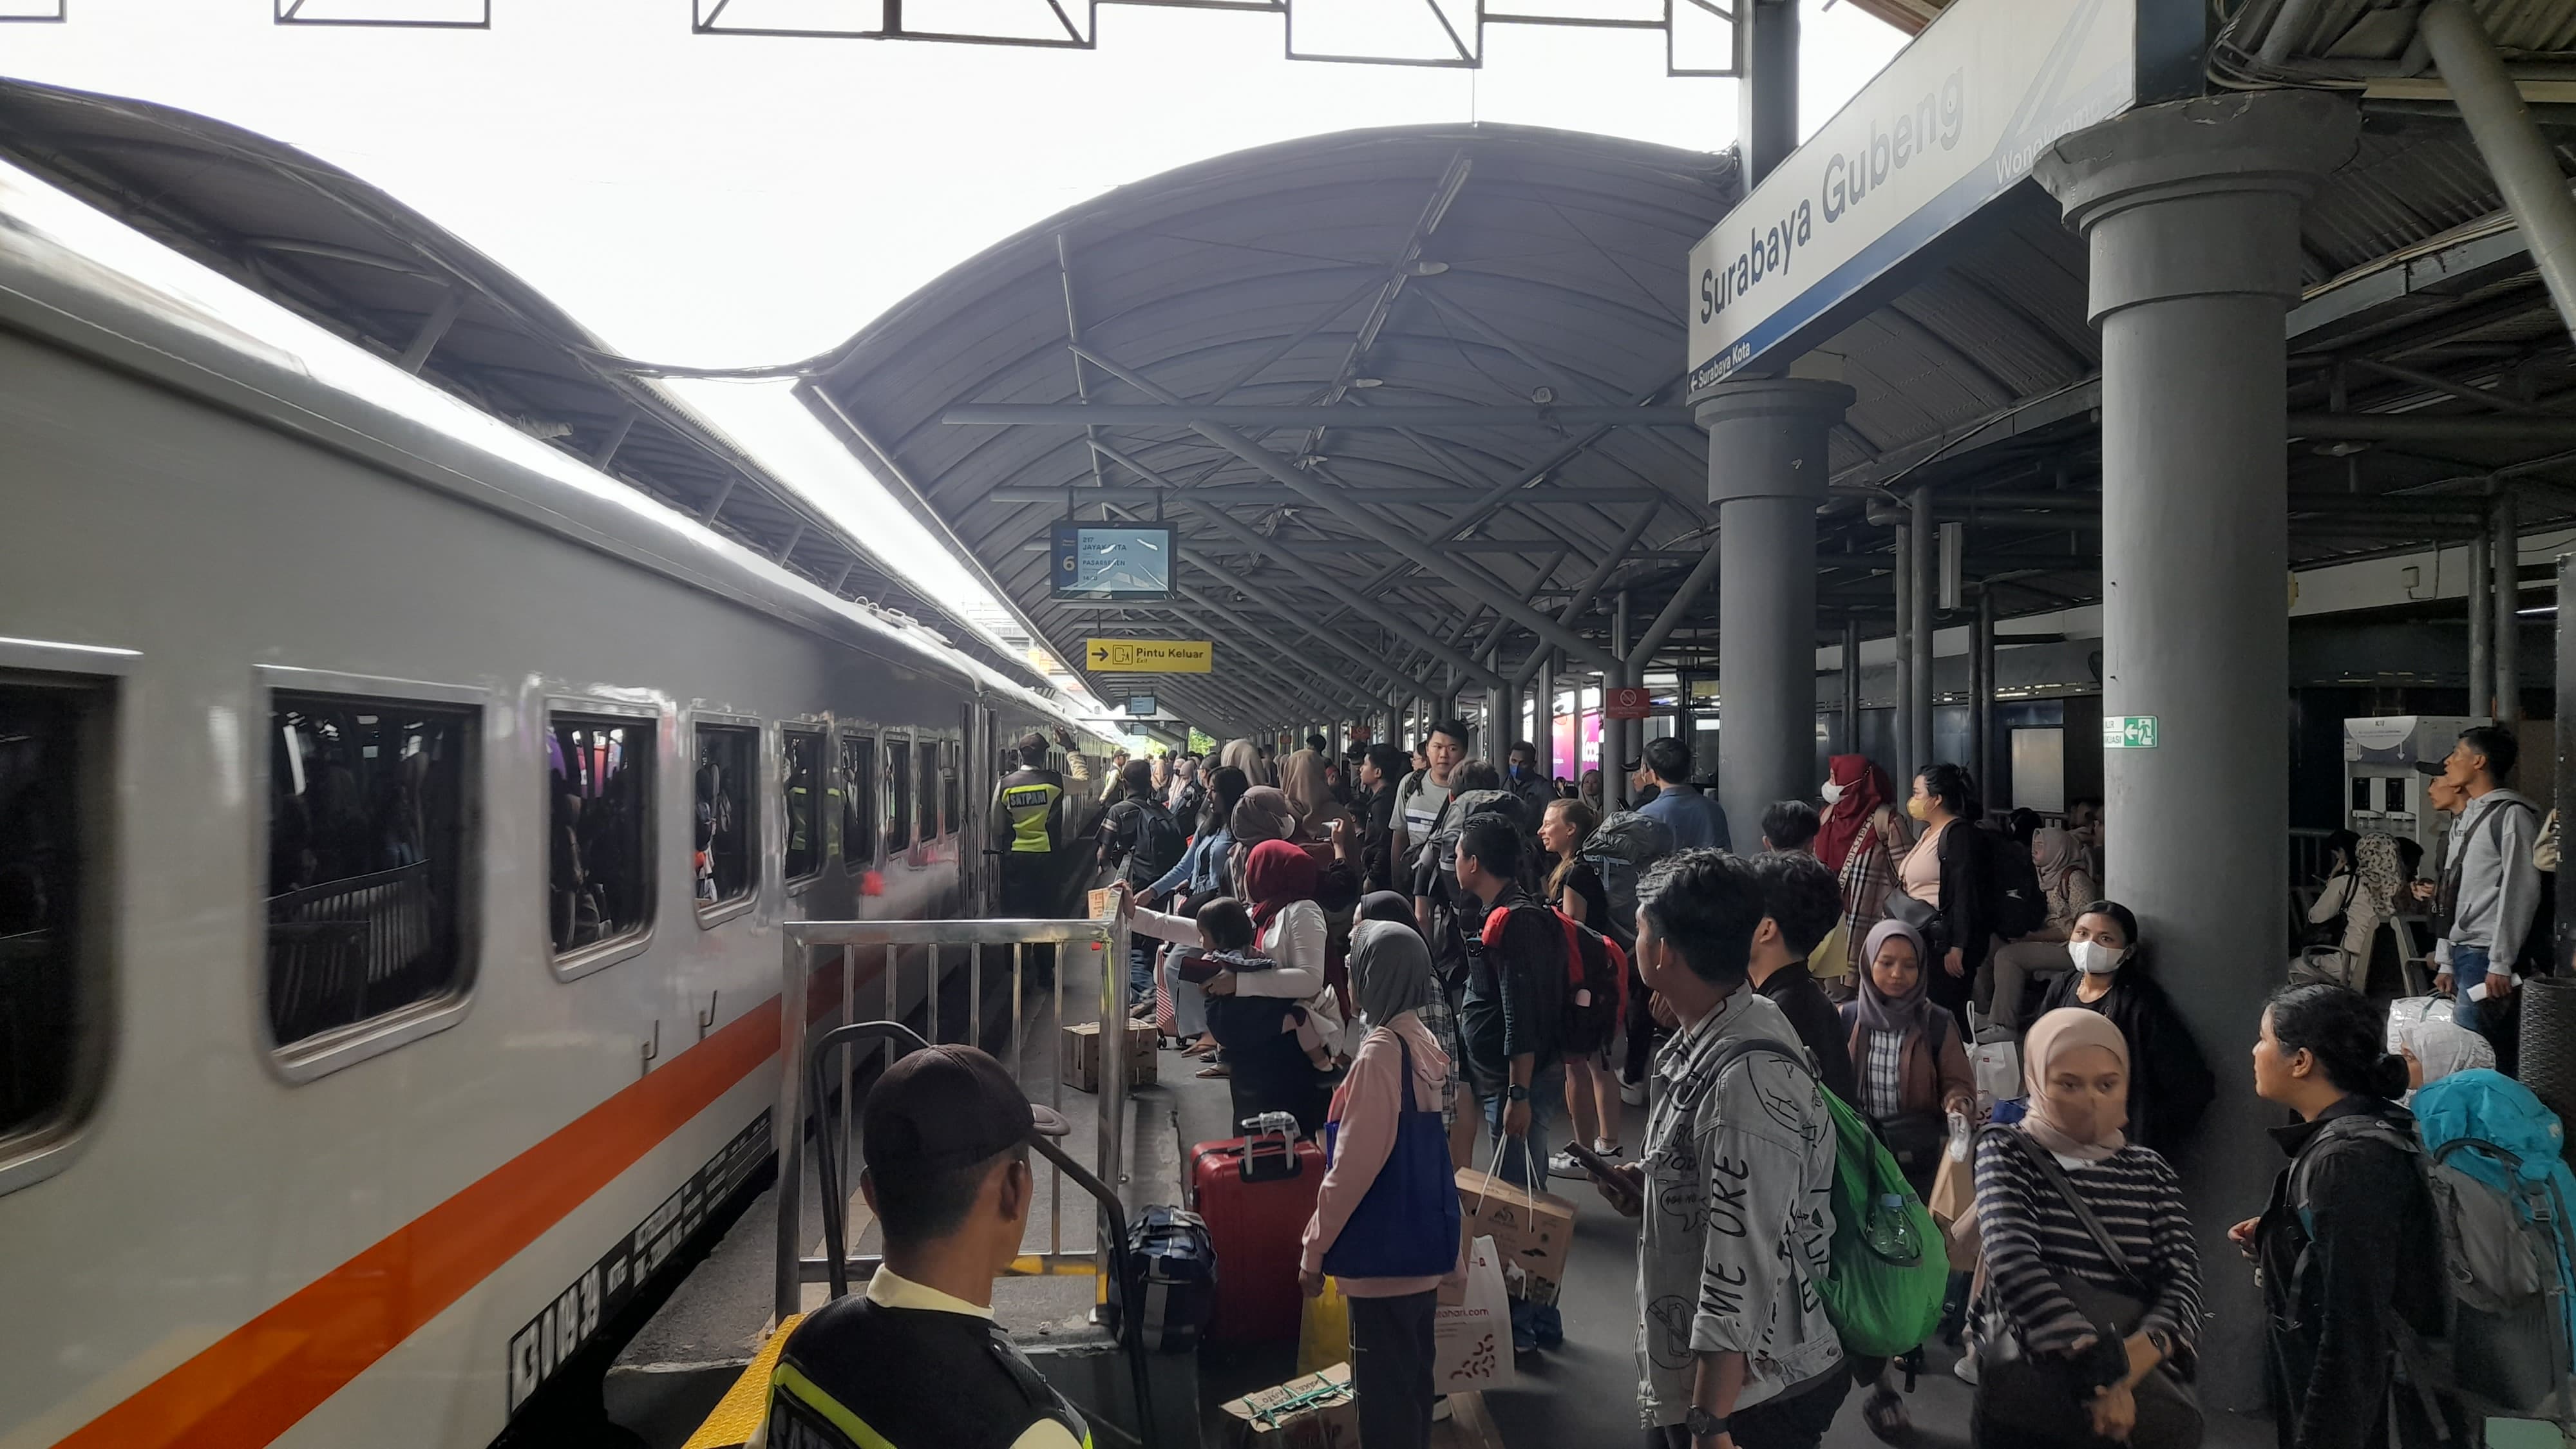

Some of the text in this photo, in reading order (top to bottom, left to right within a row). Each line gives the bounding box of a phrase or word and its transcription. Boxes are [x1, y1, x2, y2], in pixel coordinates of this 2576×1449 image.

[1701, 66, 1964, 324] Surabaya Gubeng
[1699, 342, 1750, 388] Surabaya Kota
[1063, 555, 1075, 571] 6
[1136, 647, 1204, 658] Pintu Keluar
[1010, 791, 1046, 806] SATPAM
